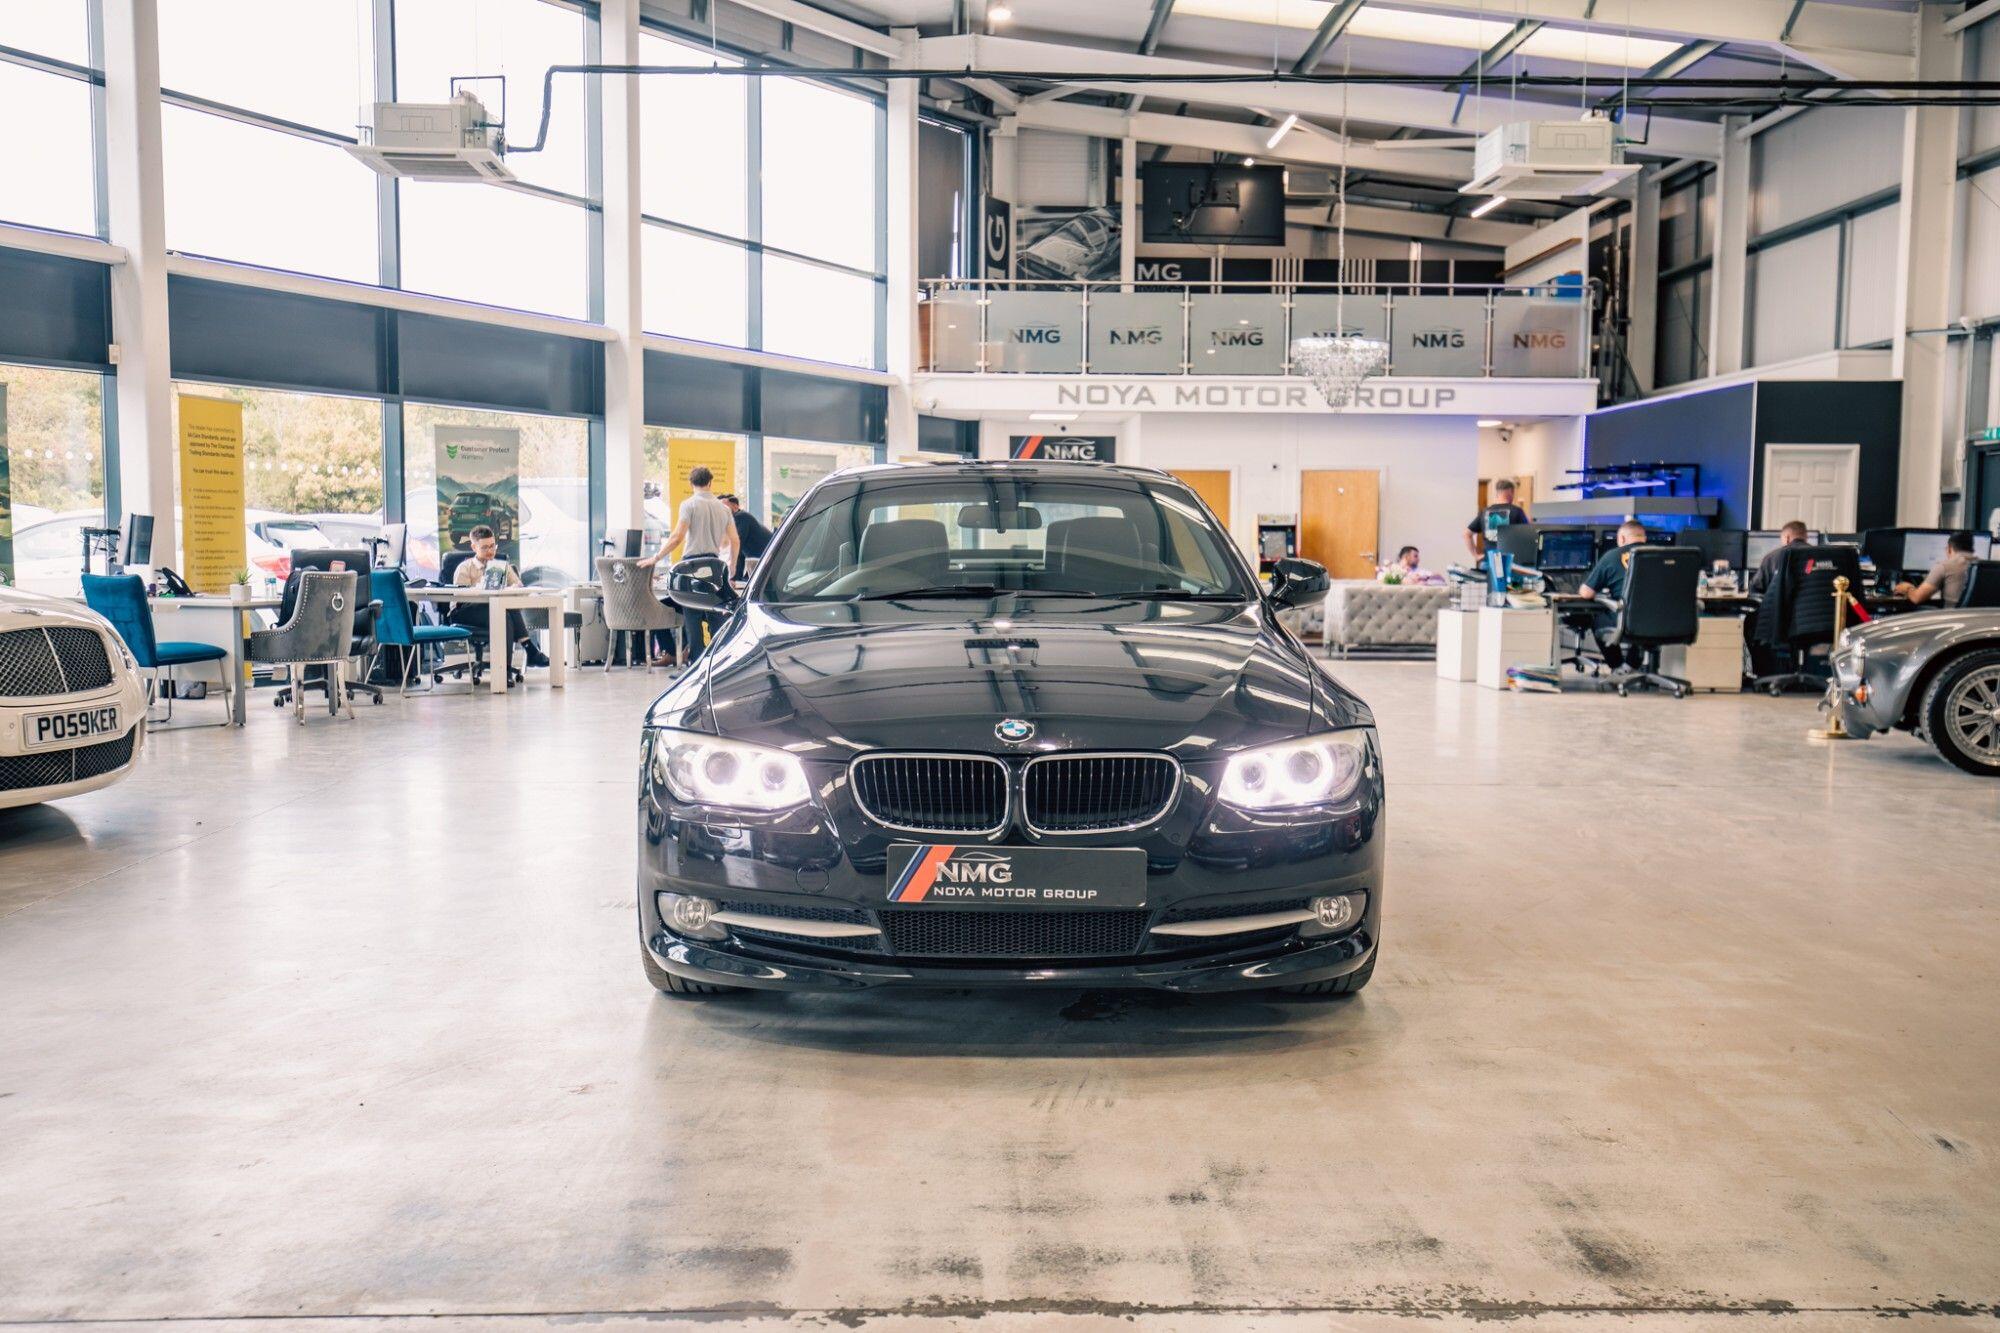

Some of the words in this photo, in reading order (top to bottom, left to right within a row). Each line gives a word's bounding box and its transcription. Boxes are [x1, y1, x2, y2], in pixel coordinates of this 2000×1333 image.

[1008, 329, 1061, 344] NMG
[1110, 330, 1162, 345] NMG
[1211, 331, 1264, 346] NMG
[1413, 333, 1465, 348] NMG
[1513, 333, 1566, 348] NMG
[1058, 385, 1156, 405] NOYA
[1175, 386, 1307, 407] MOTOR
[1044, 445, 1096, 460] NMG
[37, 707, 117, 741] PO59KER
[936, 861, 1013, 883] NMG
[933, 886, 975, 897] NOYA
[981, 888, 1036, 898] MOTOR
[1043, 889, 1097, 899] GROUP
